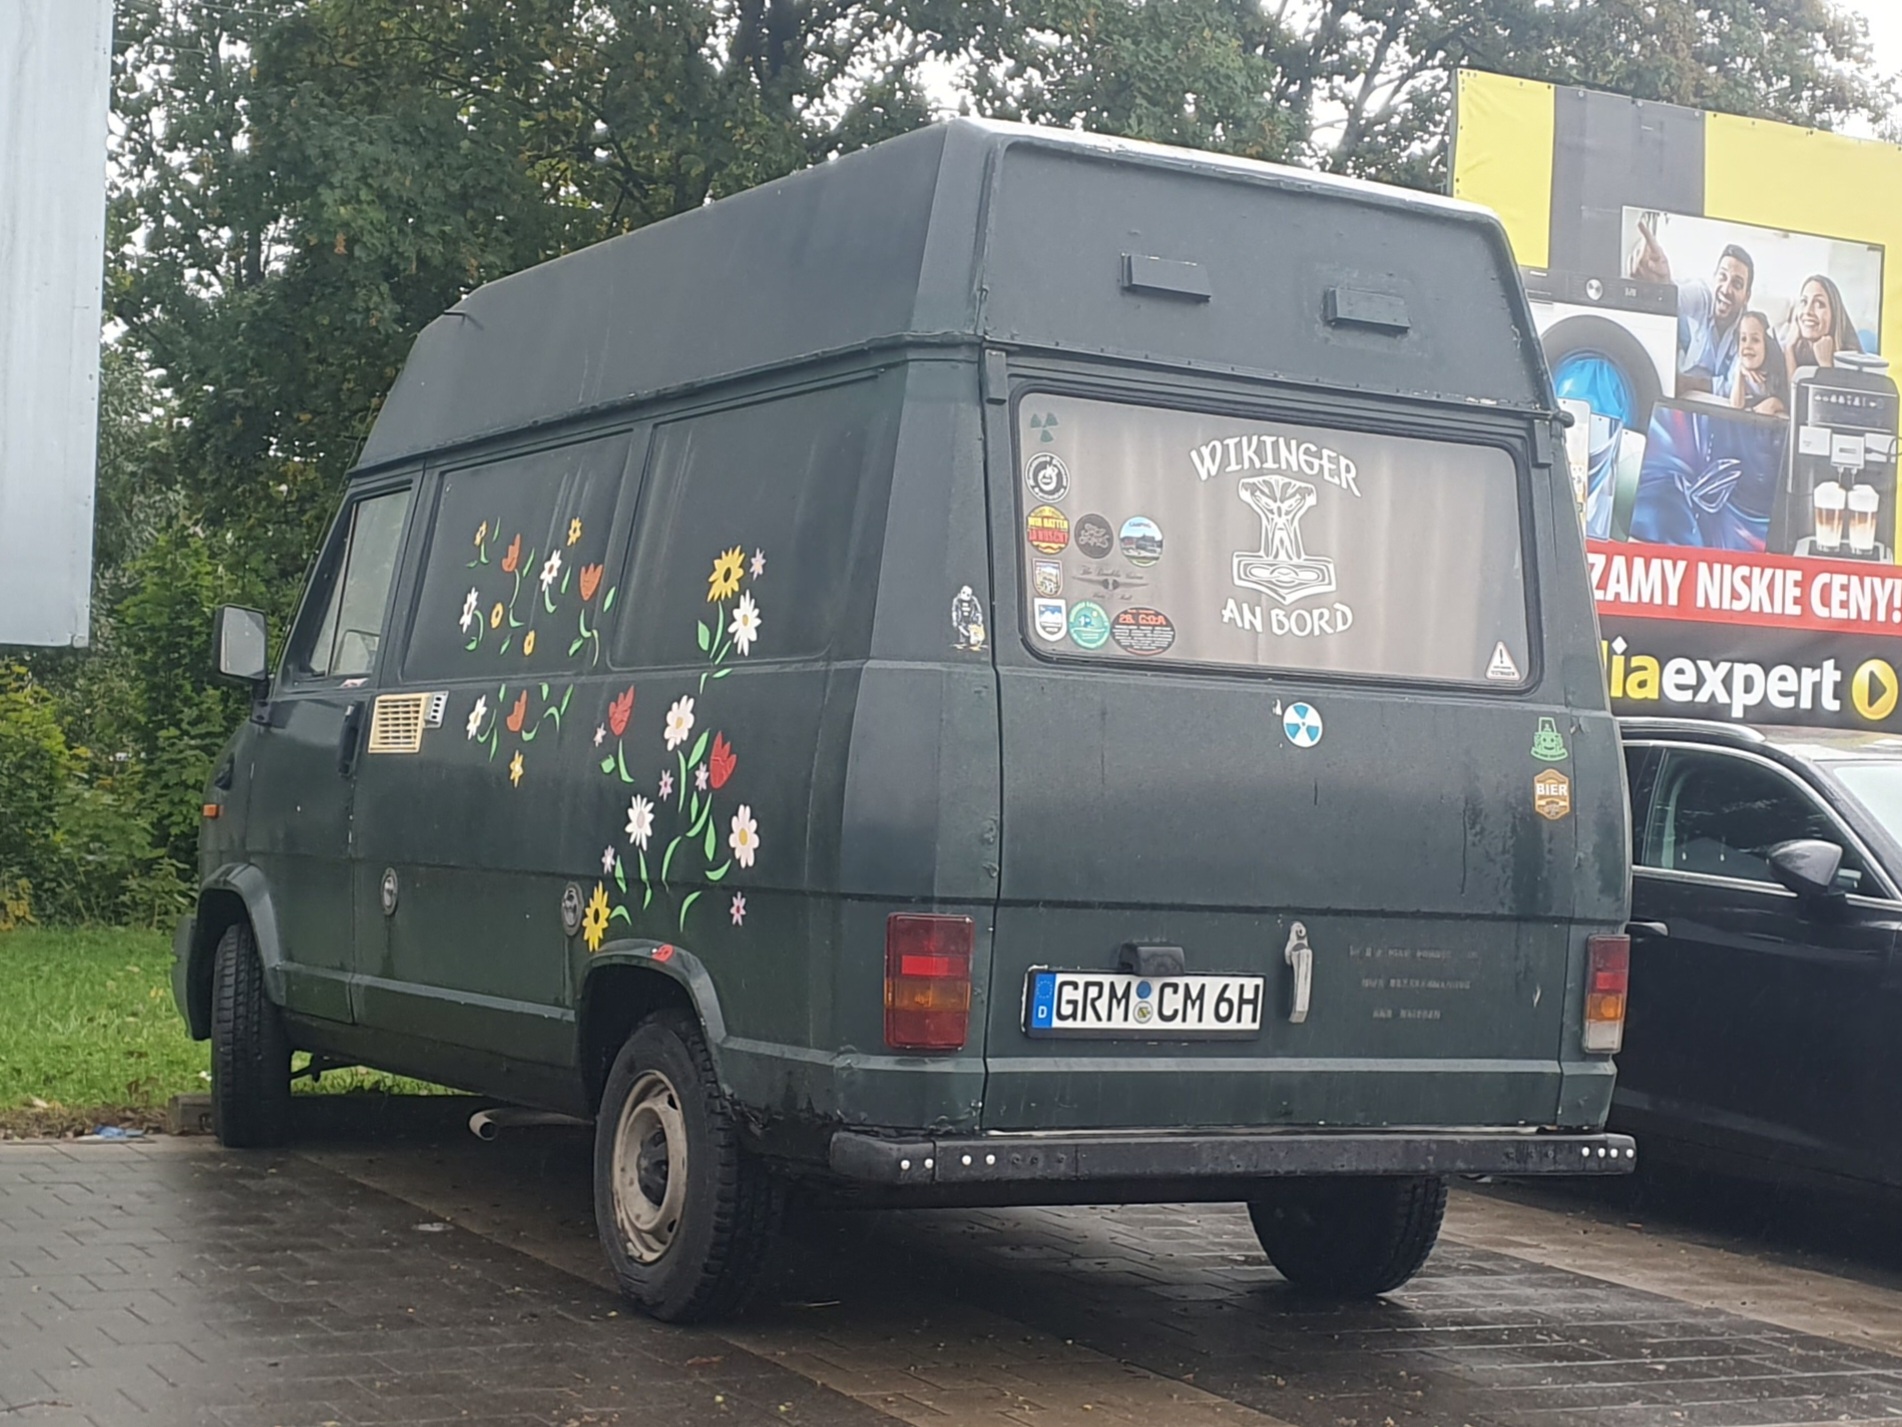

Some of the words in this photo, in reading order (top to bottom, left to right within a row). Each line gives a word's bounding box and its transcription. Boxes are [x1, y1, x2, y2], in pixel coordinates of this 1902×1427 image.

[1190, 435, 1361, 498] WIKINGER
[1587, 553, 1688, 606] ZAMY
[1696, 561, 1802, 616] NISKIE
[1810, 573, 1902, 624] CENY!
[1222, 598, 1263, 633] AN
[1270, 602, 1353, 637] BORD
[1535, 783, 1568, 796] BIER
[1038, 1006, 1047, 1018] D
[1055, 980, 1132, 1023] GRM
[1157, 982, 1206, 1024] CM
[1213, 983, 1260, 1024] 6H
